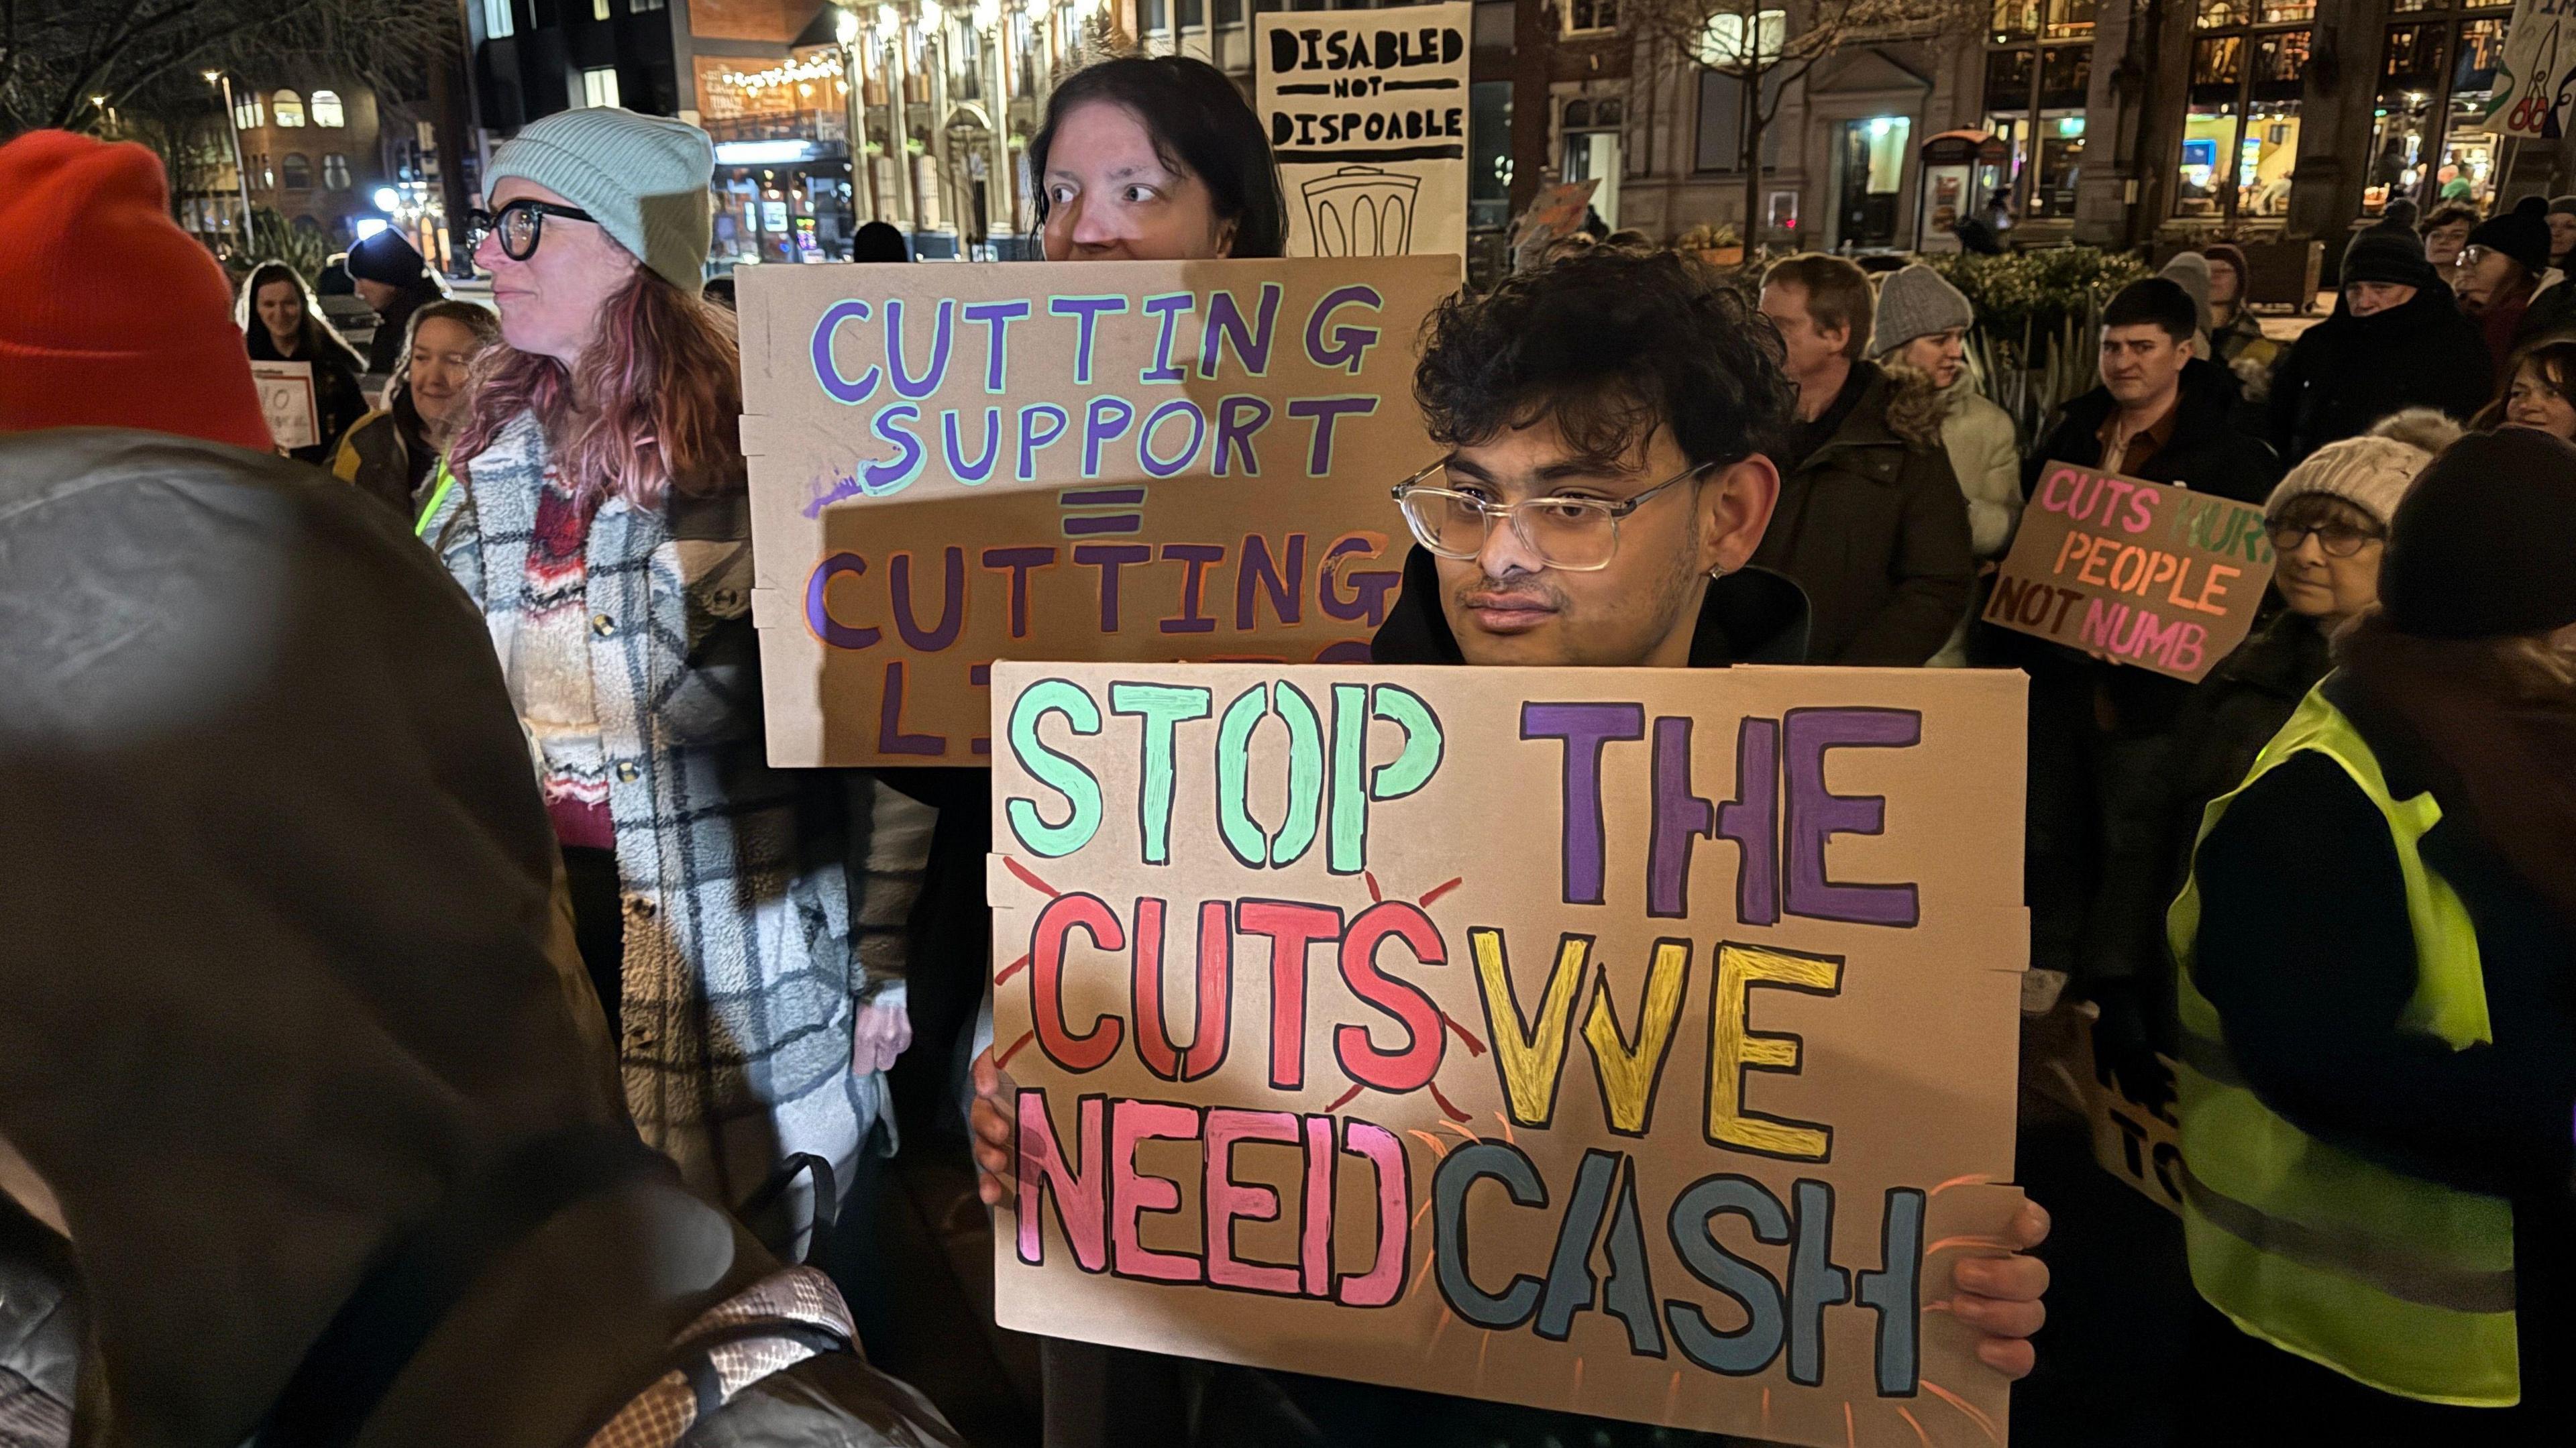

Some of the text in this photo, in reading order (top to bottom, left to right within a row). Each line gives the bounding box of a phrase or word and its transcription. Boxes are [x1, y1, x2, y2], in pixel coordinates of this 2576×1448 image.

[1269, 27, 1464, 74] DISABLED
[1334, 76, 1383, 98] NOT
[1272, 108, 1463, 146] DISPOABLE
[811, 282, 1384, 403] CUTTING
[857, 395, 1381, 496] SUPPORT
[2041, 468, 2273, 565] CUTS HUR
[802, 533, 1401, 652] CUTTING
[2053, 530, 2241, 616] PEOPLE
[1988, 575, 2208, 672] NOT NUMB
[1006, 678, 1446, 875] STOP
[1519, 700, 1923, 928] THE
[1029, 890, 1845, 1163] CUTS WE
[1014, 1087, 1926, 1398] NEED CASH
